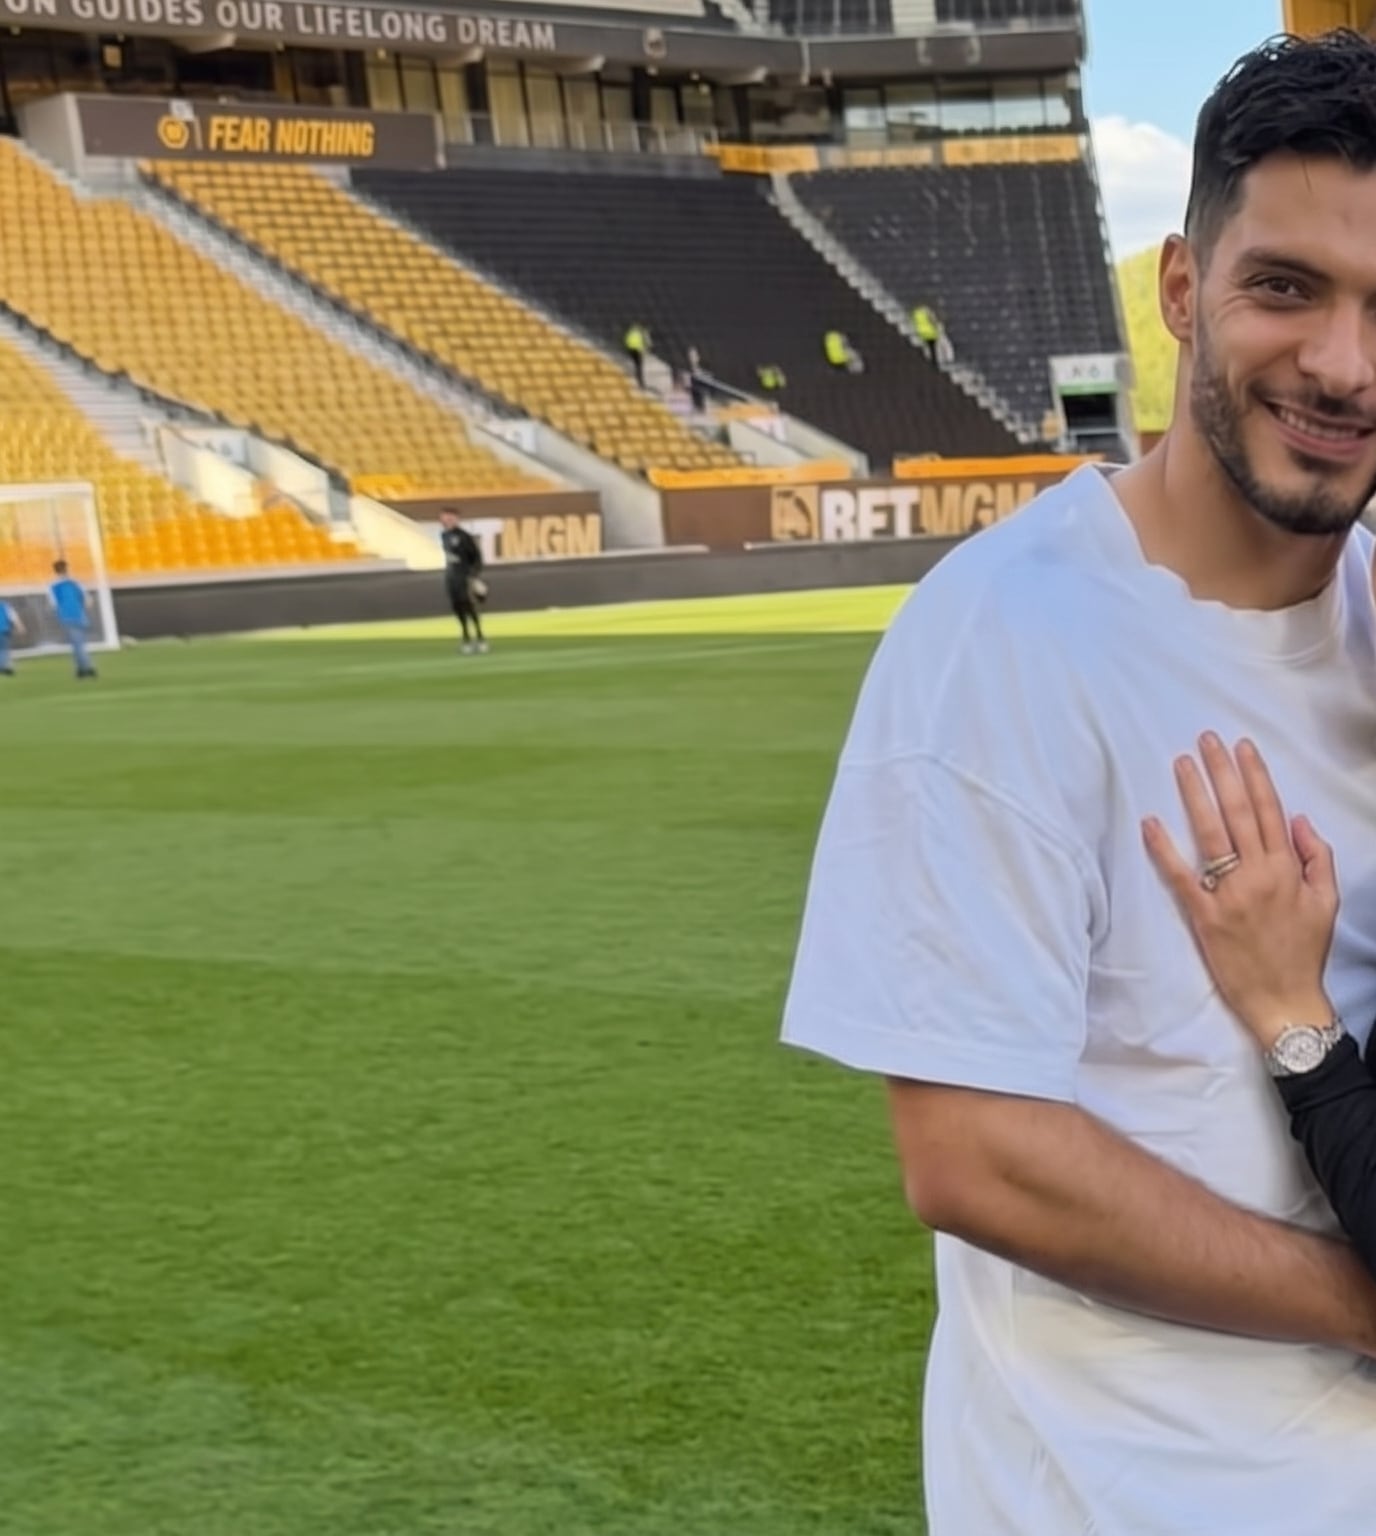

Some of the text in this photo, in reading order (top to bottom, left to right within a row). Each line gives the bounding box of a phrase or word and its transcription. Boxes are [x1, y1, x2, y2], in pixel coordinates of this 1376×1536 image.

[72, 0, 204, 26] GUIDES
[215, 1, 284, 31] OUR
[296, 5, 447, 43] LIFELONG
[457, 17, 556, 50] DREAM
[208, 115, 375, 157] FEAR NOTHING
